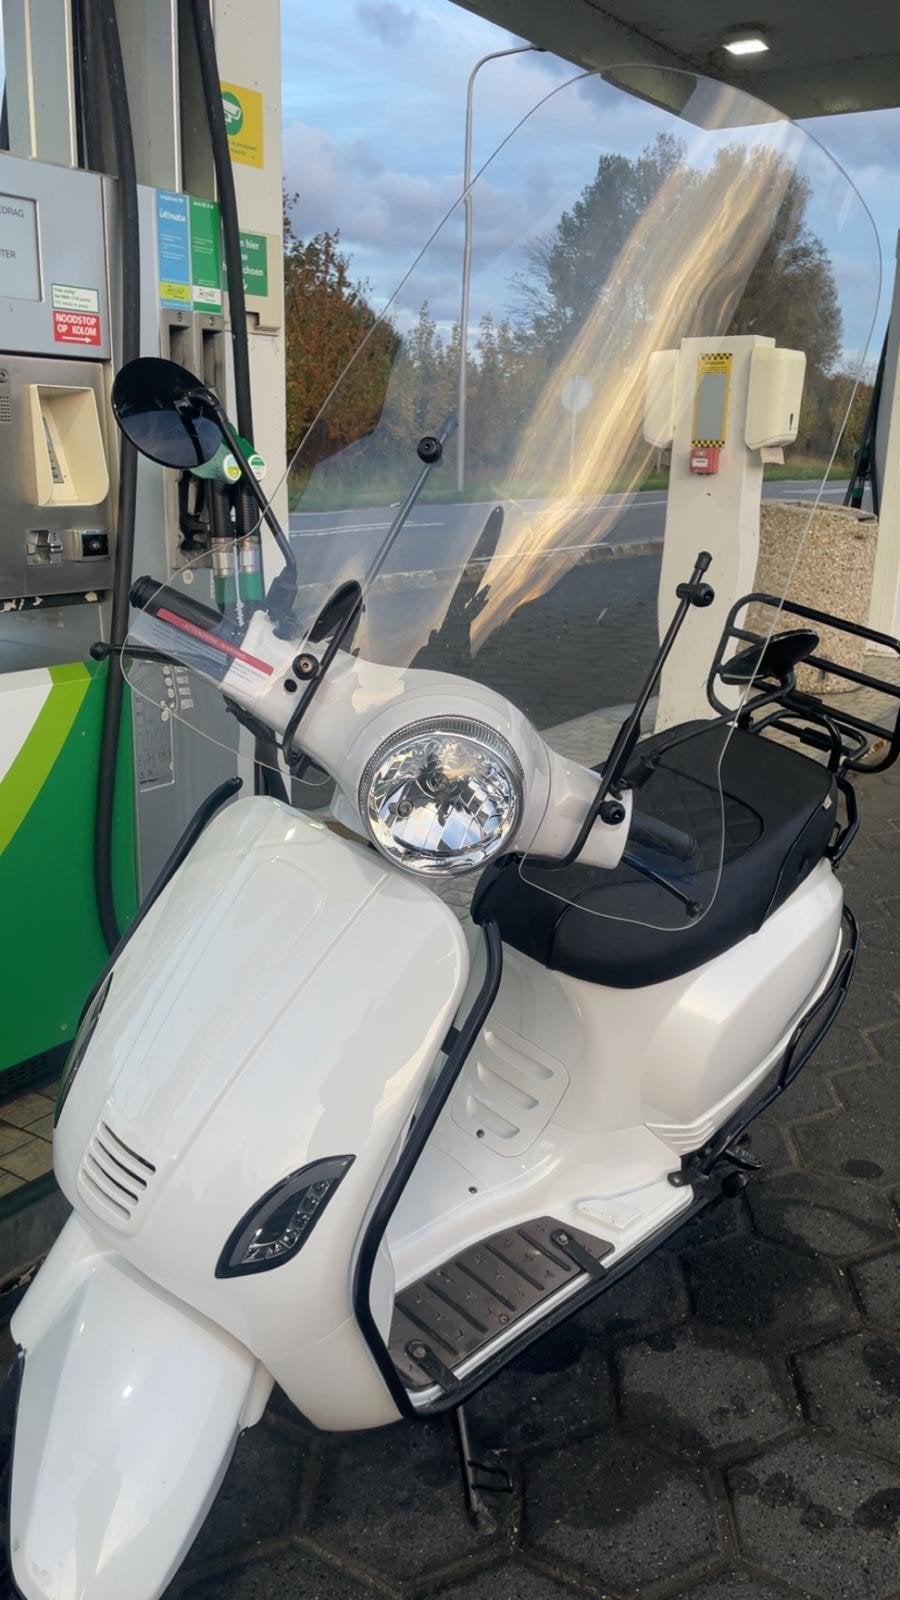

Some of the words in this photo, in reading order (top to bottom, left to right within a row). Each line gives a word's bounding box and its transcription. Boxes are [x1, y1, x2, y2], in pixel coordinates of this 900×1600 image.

[55, 313, 97, 326] NOODSTOP
[57, 324, 68, 333] OP
[72, 326, 97, 337] KOLOM
